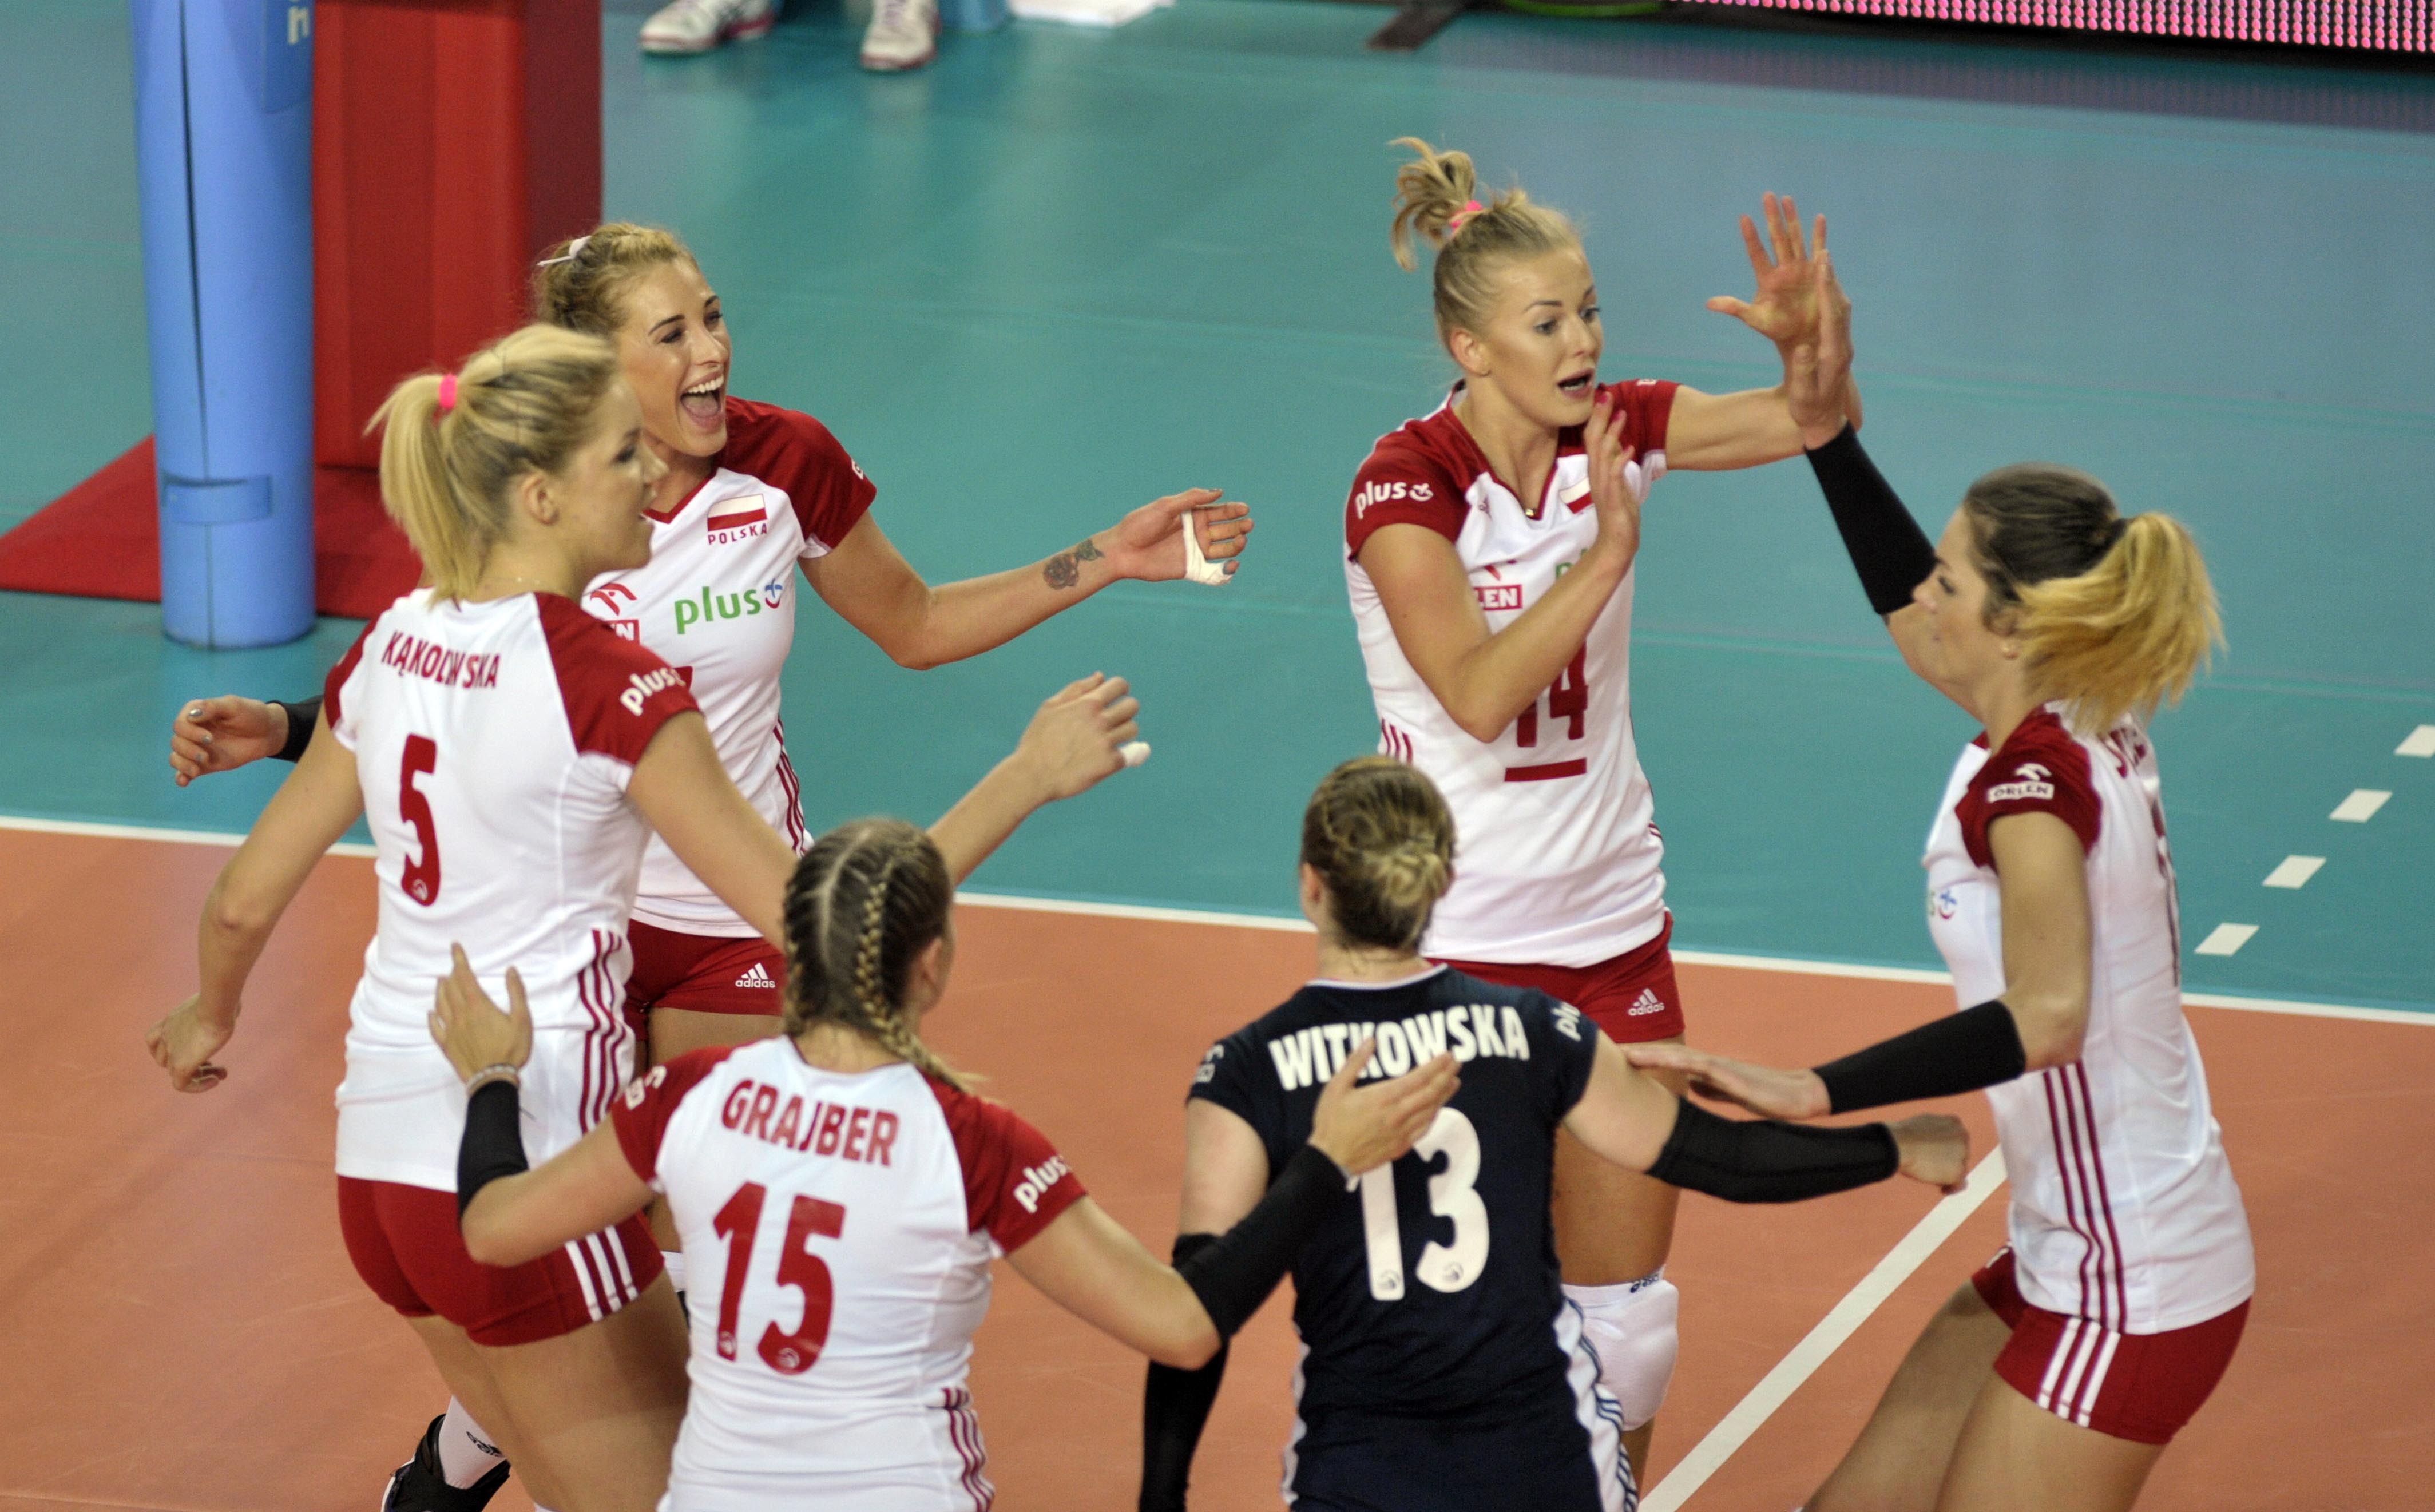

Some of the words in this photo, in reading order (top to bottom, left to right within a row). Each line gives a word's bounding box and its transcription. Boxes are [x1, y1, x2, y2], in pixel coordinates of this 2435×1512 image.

[1355, 481, 1407, 520] plus
[707, 523, 768, 545] POLSKA
[674, 585, 762, 634] plus
[620, 667, 676, 717] plus
[399, 732, 441, 907] 5
[735, 979, 776, 989] adidas
[1628, 1002, 1665, 1017] adidas
[1267, 1004, 1530, 1091] WITKOWSKA
[721, 1079, 901, 1167] GRAJBER
[1013, 1154, 1068, 1214] plus
[1347, 1106, 1490, 1301] 13
[713, 1180, 846, 1375] 15
